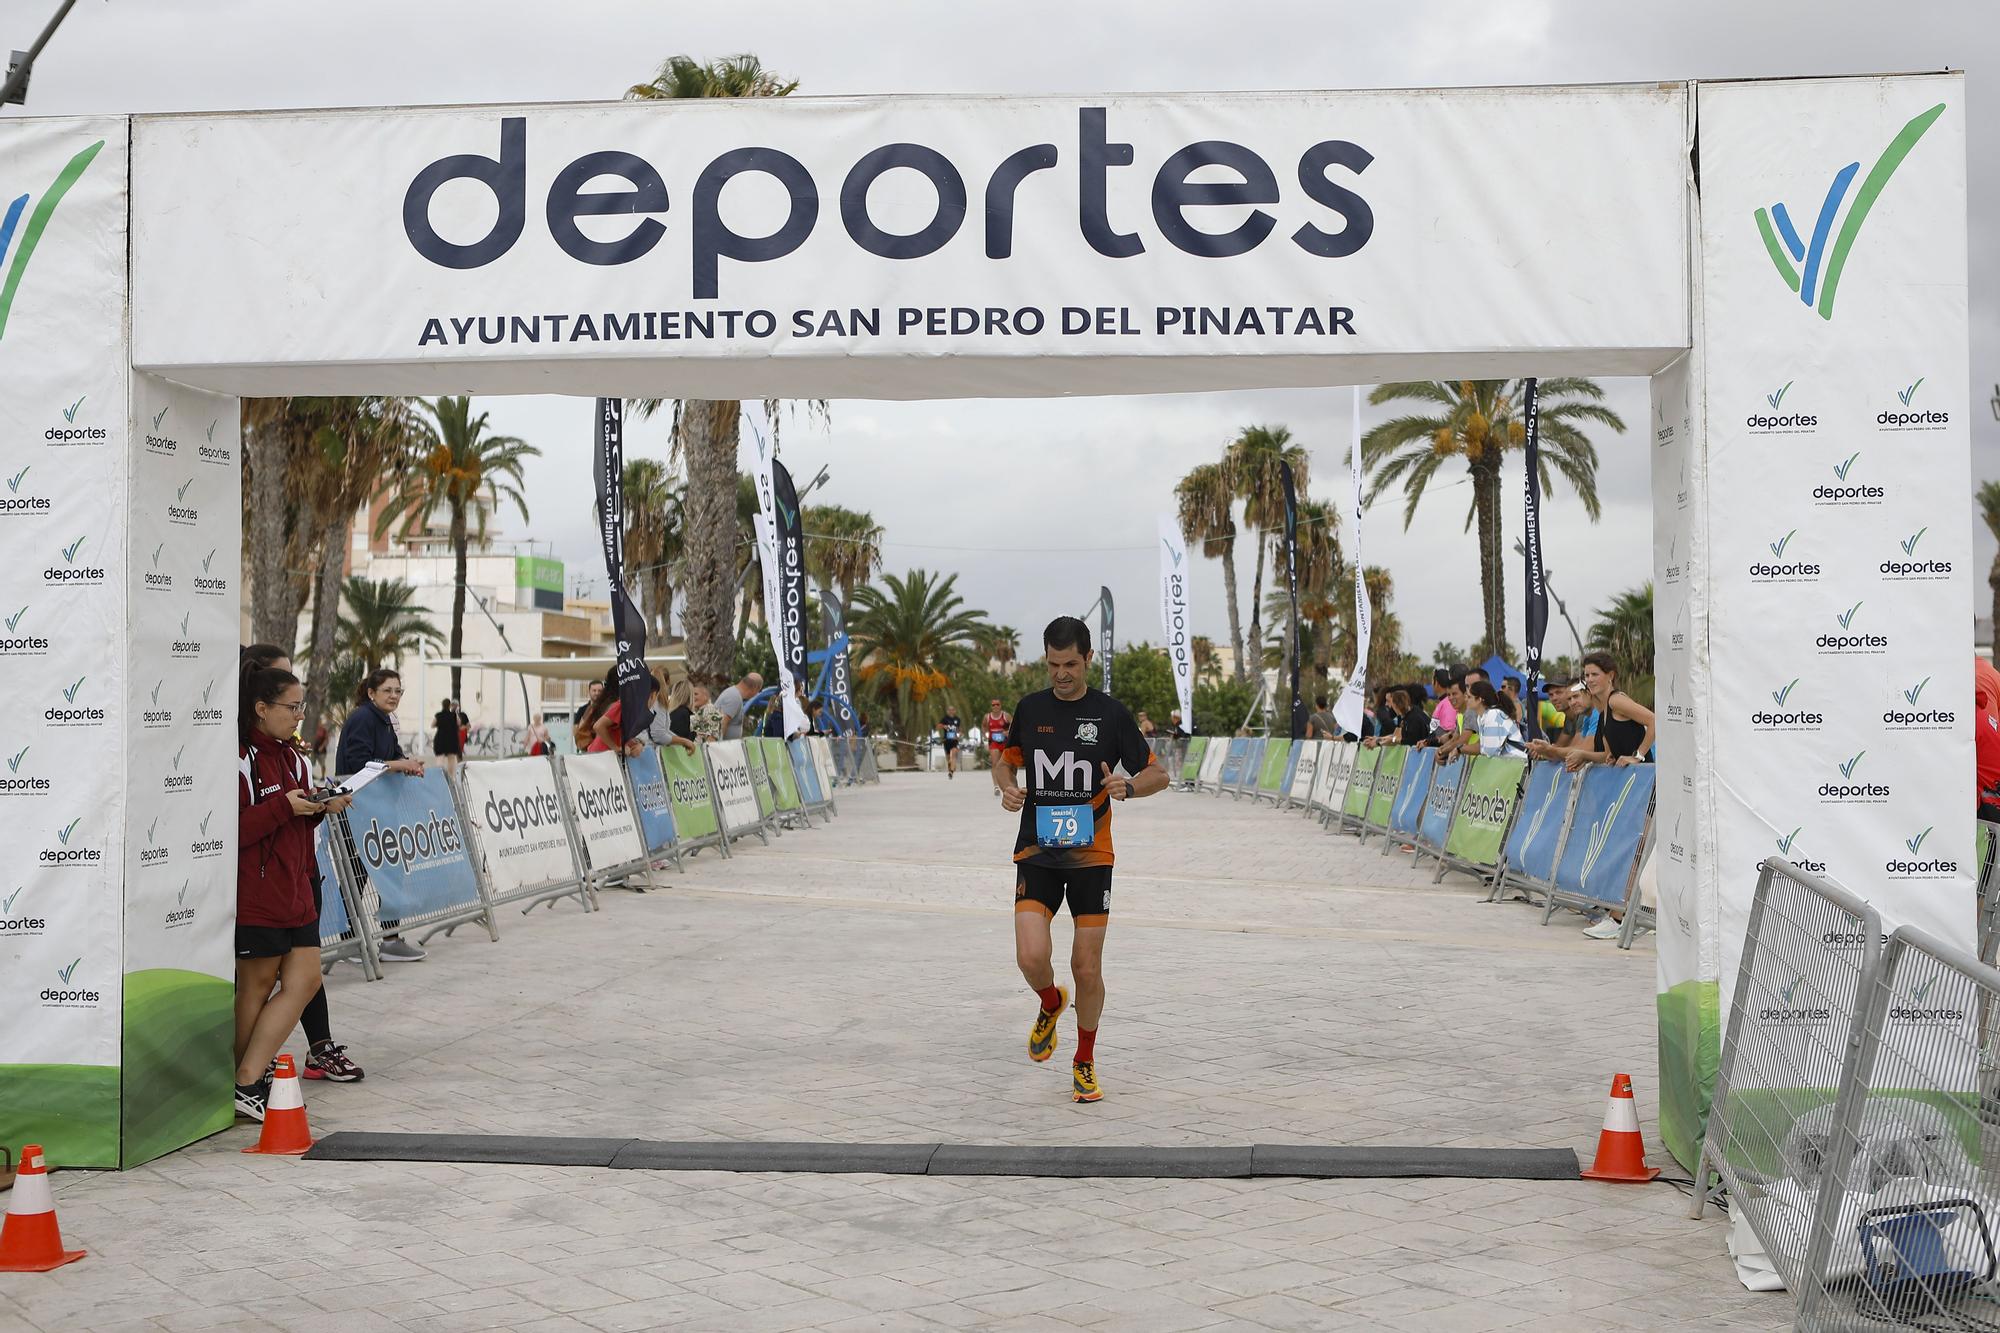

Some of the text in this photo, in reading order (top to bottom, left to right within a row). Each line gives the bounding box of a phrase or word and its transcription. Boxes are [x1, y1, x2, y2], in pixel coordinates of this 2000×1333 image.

[402, 107, 1374, 299] deportes
[418, 305, 1356, 345] AYUNTAMIENTO SAN PEDRO DEL PINATAR
[1747, 413, 1818, 430] deportes
[1877, 410, 1949, 428] deportes
[45, 427, 106, 442] deportes
[146, 433, 177, 450] deportes
[199, 444, 230, 460] deportes
[1813, 484, 1884, 501] deportes
[0, 497, 50, 512] eportes
[168, 505, 198, 520] deportes
[1525, 494, 1541, 596] AYUNTAMIENTO
[44, 567, 104, 581] deportes
[1750, 562, 1820, 578] deportes
[1880, 560, 1952, 576] deportes
[145, 571, 172, 586] deportes
[194, 576, 226, 590] deportes
[1816, 634, 1888, 650] deportes
[45, 707, 104, 722] deportes
[143, 709, 172, 724] deportes
[193, 708, 223, 723] deportes
[1752, 711, 1823, 727] deportes
[1883, 710, 1955, 726] deportes
[1034, 749, 1093, 791] Mh
[0, 777, 49, 792] eportes
[164, 773, 193, 789] deportes
[1818, 783, 1890, 799] deportes
[1052, 818, 1078, 837] 79
[191, 838, 224, 854] deportes
[363, 809, 461, 875] deportes
[39, 848, 101, 863] deportes
[140, 846, 168, 861] deportes
[1886, 859, 1957, 875] deportes
[165, 906, 195, 923] deportes
[41, 988, 99, 1003] deportes
